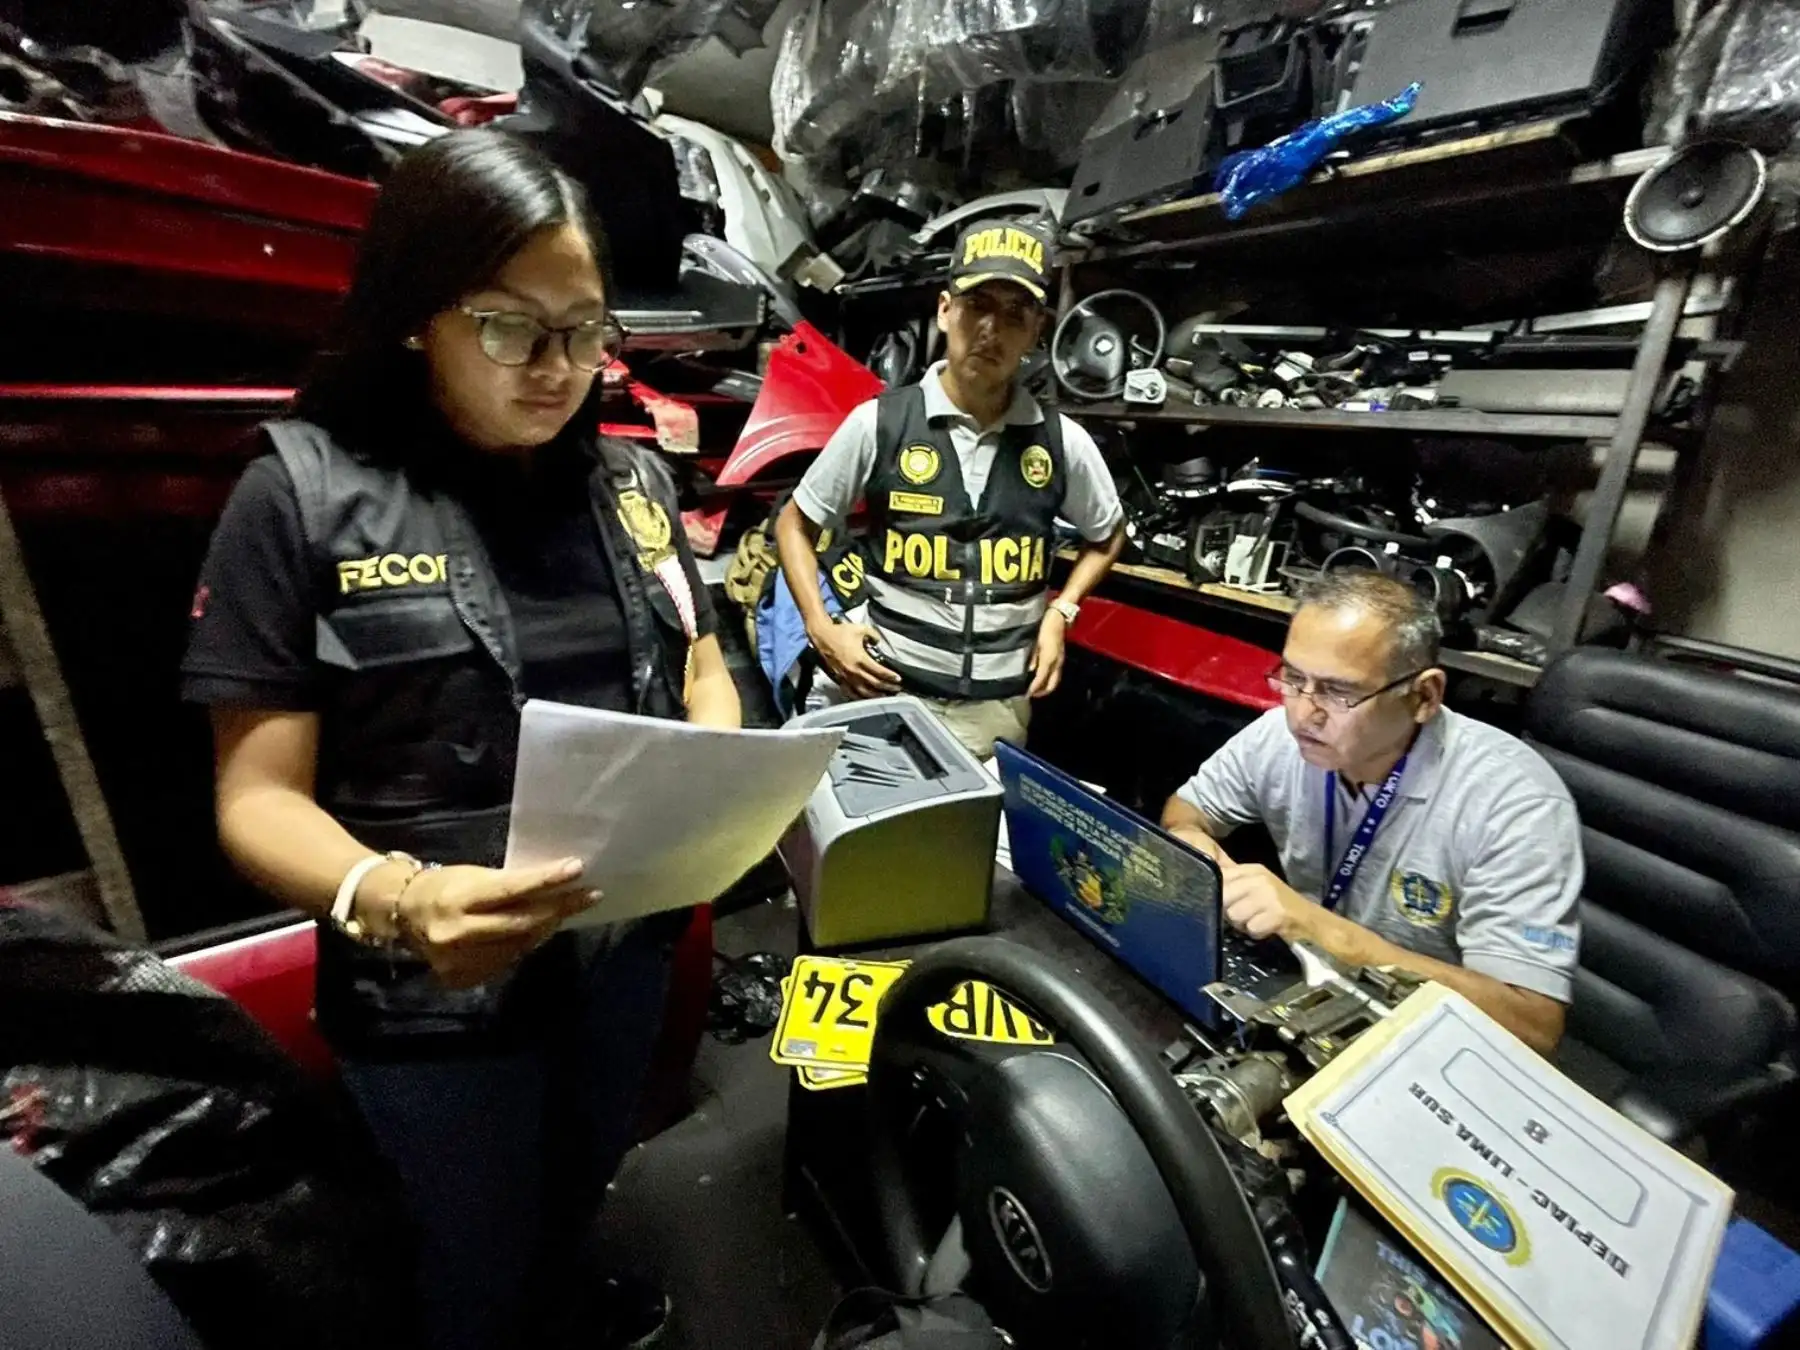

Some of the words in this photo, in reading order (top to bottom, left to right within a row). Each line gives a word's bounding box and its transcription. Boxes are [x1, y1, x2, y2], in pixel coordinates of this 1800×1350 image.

[962, 227, 1044, 275] POLICIA
[1374, 770, 1402, 809] TOKYO
[1339, 843, 1366, 876] TOKYO
[803, 970, 874, 1028] 34
[1408, 1081, 1455, 1126] SUR
[1456, 1122, 1514, 1178] LIMA
[1530, 1188, 1631, 1279] DEPIAC
